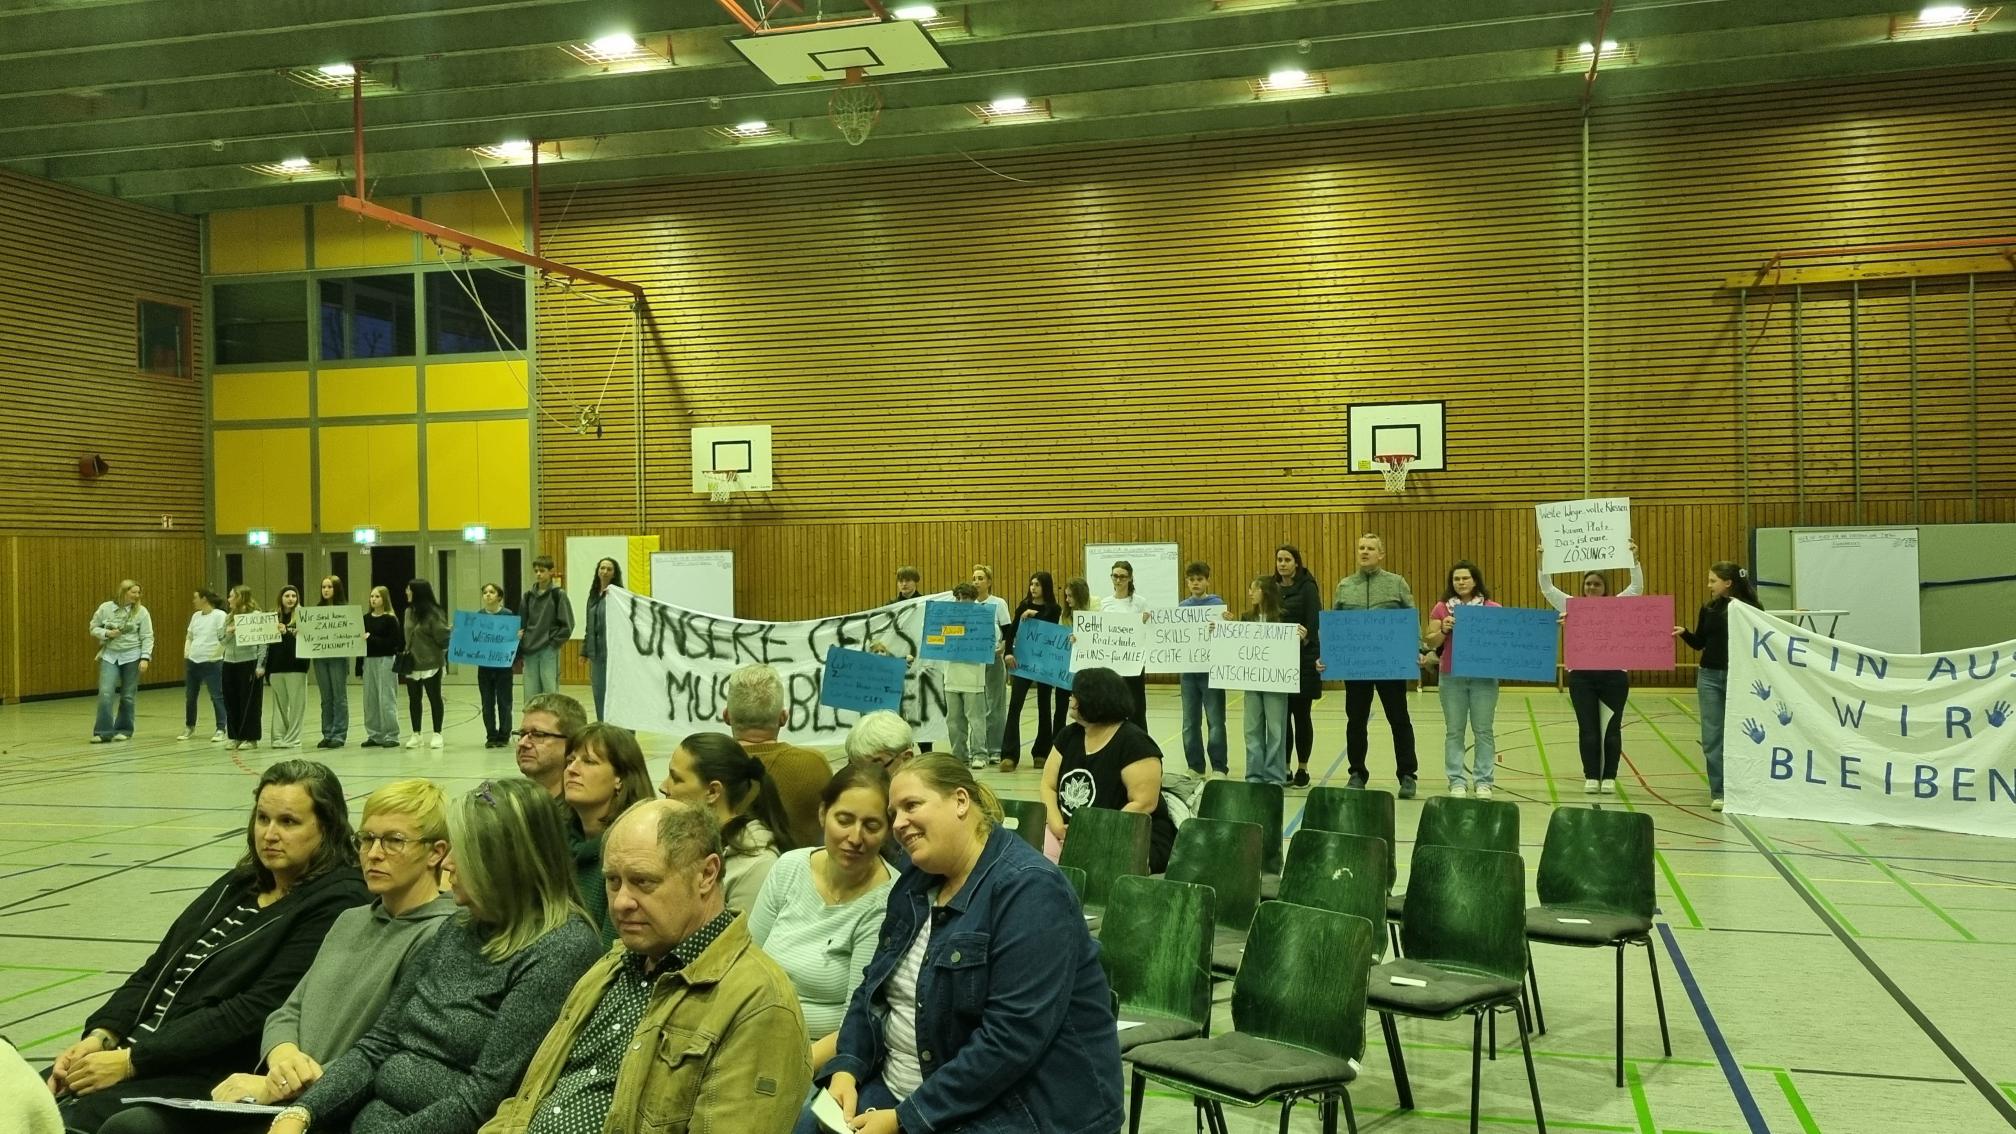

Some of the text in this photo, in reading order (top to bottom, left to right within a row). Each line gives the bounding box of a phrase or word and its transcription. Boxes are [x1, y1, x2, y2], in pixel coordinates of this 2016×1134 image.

[1605, 500, 1628, 513] Klassen
[1554, 538, 1575, 548] Das
[1577, 535, 1587, 544] ist
[1563, 545, 1615, 563] LÖSUNG?
[236, 614, 278, 626] ZUKUNFT
[299, 610, 314, 623] Wir
[316, 613, 330, 621] sind
[1077, 615, 1134, 634] Rettet unsere
[303, 633, 314, 643] Wir
[631, 596, 795, 665] UNSERE
[1156, 629, 1191, 643] SKILLS
[1213, 623, 1296, 640] UNSERE ZUKUNFT
[312, 640, 354, 651] ZUKUNFT!
[1092, 633, 1136, 648] Realschule
[1149, 649, 1182, 663] ECHTE
[1238, 646, 1271, 662] EURE
[1752, 626, 1888, 680] KEIN
[1210, 665, 1299, 685] ENTSCHEIDUNG?
[667, 670, 733, 722] MUS
[787, 667, 948, 733] BLEN
[1831, 696, 1973, 739] WIR
[1770, 747, 2016, 804] BLEIBEN
